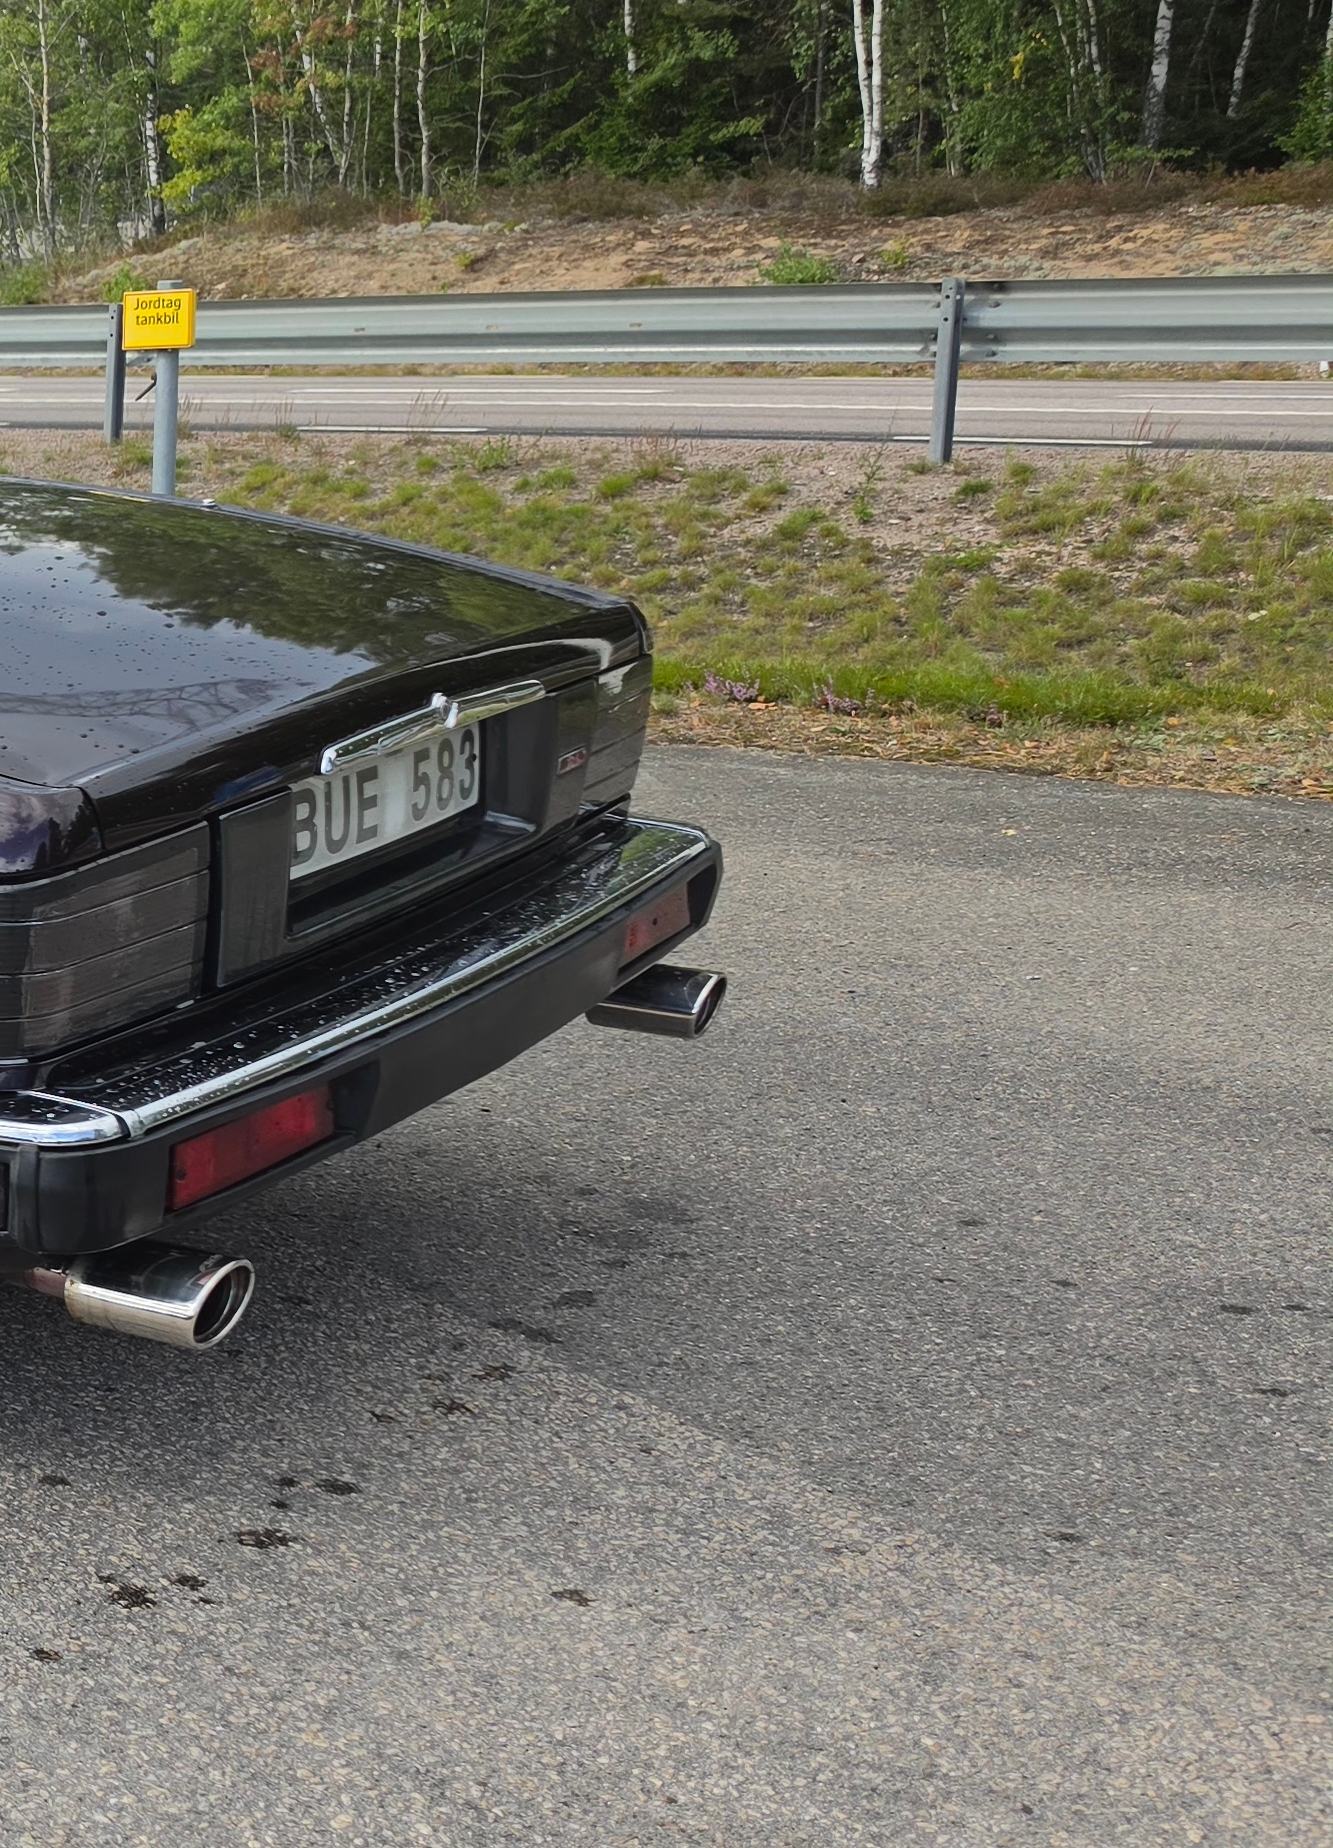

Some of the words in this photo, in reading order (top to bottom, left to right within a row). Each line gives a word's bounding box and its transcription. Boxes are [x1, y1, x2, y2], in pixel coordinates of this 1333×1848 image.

[134, 297, 181, 311] Jordtag
[136, 311, 179, 325] tankbil
[290, 765, 378, 868] BUE
[411, 727, 476, 822] 583
